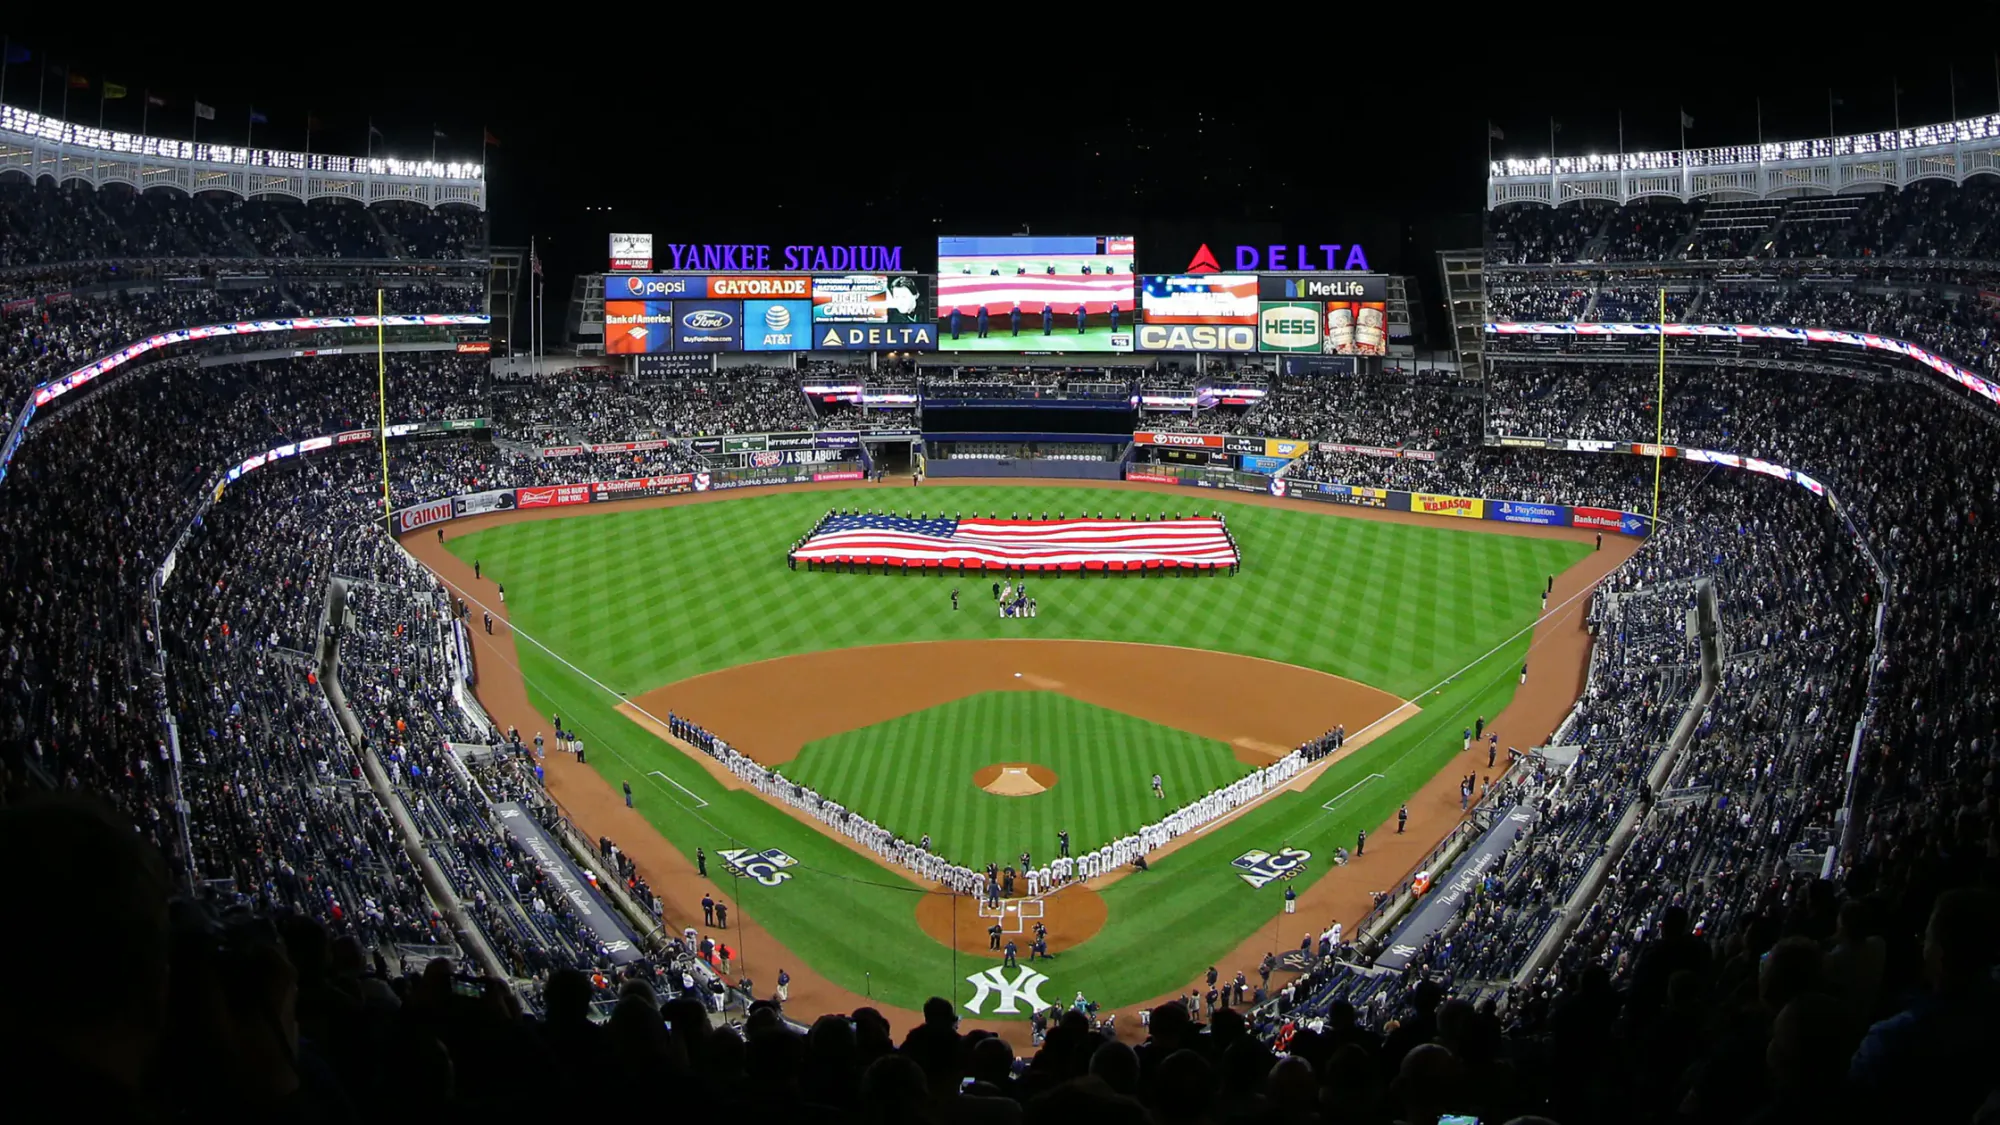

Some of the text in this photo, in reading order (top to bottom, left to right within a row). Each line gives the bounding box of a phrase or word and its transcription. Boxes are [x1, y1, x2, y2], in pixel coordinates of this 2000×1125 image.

[668, 243, 902, 272] YANKEE STADIUM
[1236, 244, 1369, 271] DELTA
[646, 279, 686, 295] pepsi
[714, 280, 806, 295] GATORADE
[1309, 281, 1364, 296] MetLife
[823, 304, 876, 316] CANNATA
[606, 314, 671, 325] Bank of America
[691, 312, 724, 328] Ford
[1265, 319, 1316, 335] HESS
[683, 336, 733, 344] BuyFordNow.com
[763, 334, 793, 346] AT&T
[849, 329, 931, 345] DELTA
[1140, 326, 1255, 351] CASIO
[457, 344, 491, 353] Budweiser
[338, 432, 372, 443] RUTGERS
[1167, 436, 1205, 445] TOYOTA
[1226, 444, 1263, 452] COACH
[1278, 445, 1293, 453] SAP
[786, 449, 843, 463] A SUB ABOVE
[1211, 452, 1228, 460] FedEx
[713, 481, 737, 490] StubHub
[737, 479, 762, 487] StubHub
[763, 476, 787, 485] StubHub
[557, 486, 588, 495] THIS BUD'S
[557, 495, 570, 503] FOR
[401, 503, 451, 529] Canon
[1515, 505, 1556, 516] PlayStation
[1574, 514, 1626, 529] Bank of America
[716, 848, 793, 886] ALCS
[1239, 847, 1312, 889] ALCS
[1279, 863, 1308, 882] 2017
[1436, 853, 1493, 906] New York Yankees
[963, 964, 1053, 1015] NY
